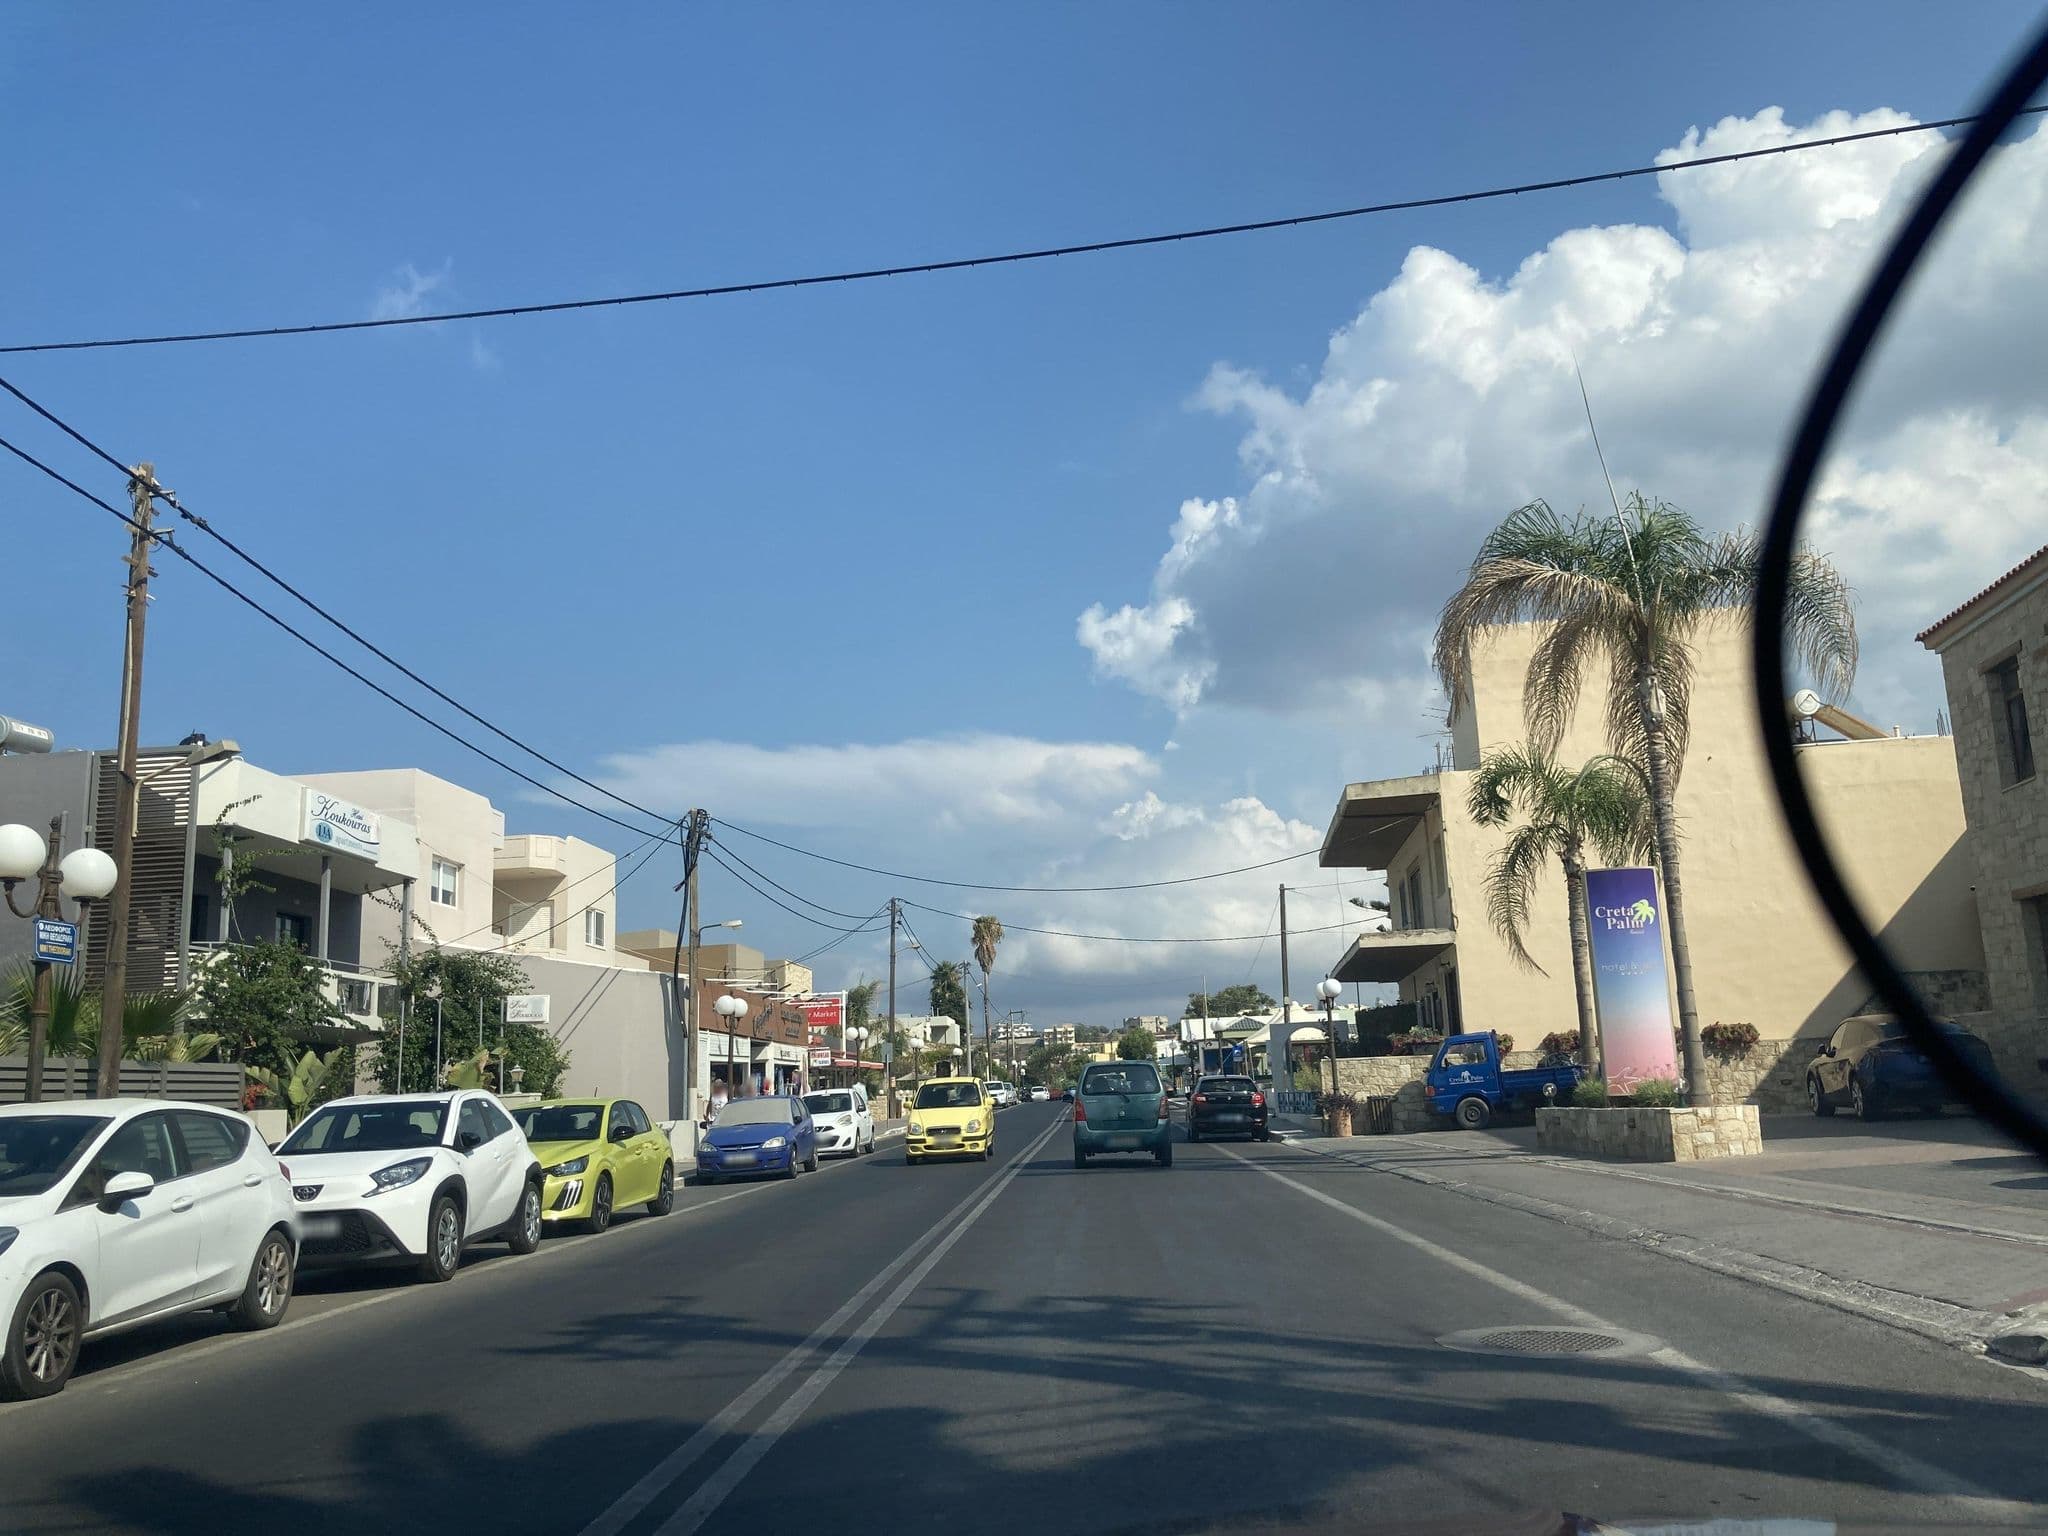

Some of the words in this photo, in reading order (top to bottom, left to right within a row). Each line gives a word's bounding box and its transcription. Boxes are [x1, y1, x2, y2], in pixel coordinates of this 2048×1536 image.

[311, 796, 372, 834] Koukouras
[1594, 905, 1634, 918] Creta
[1607, 916, 1645, 930] Palm
[813, 1010, 837, 1018] Market
